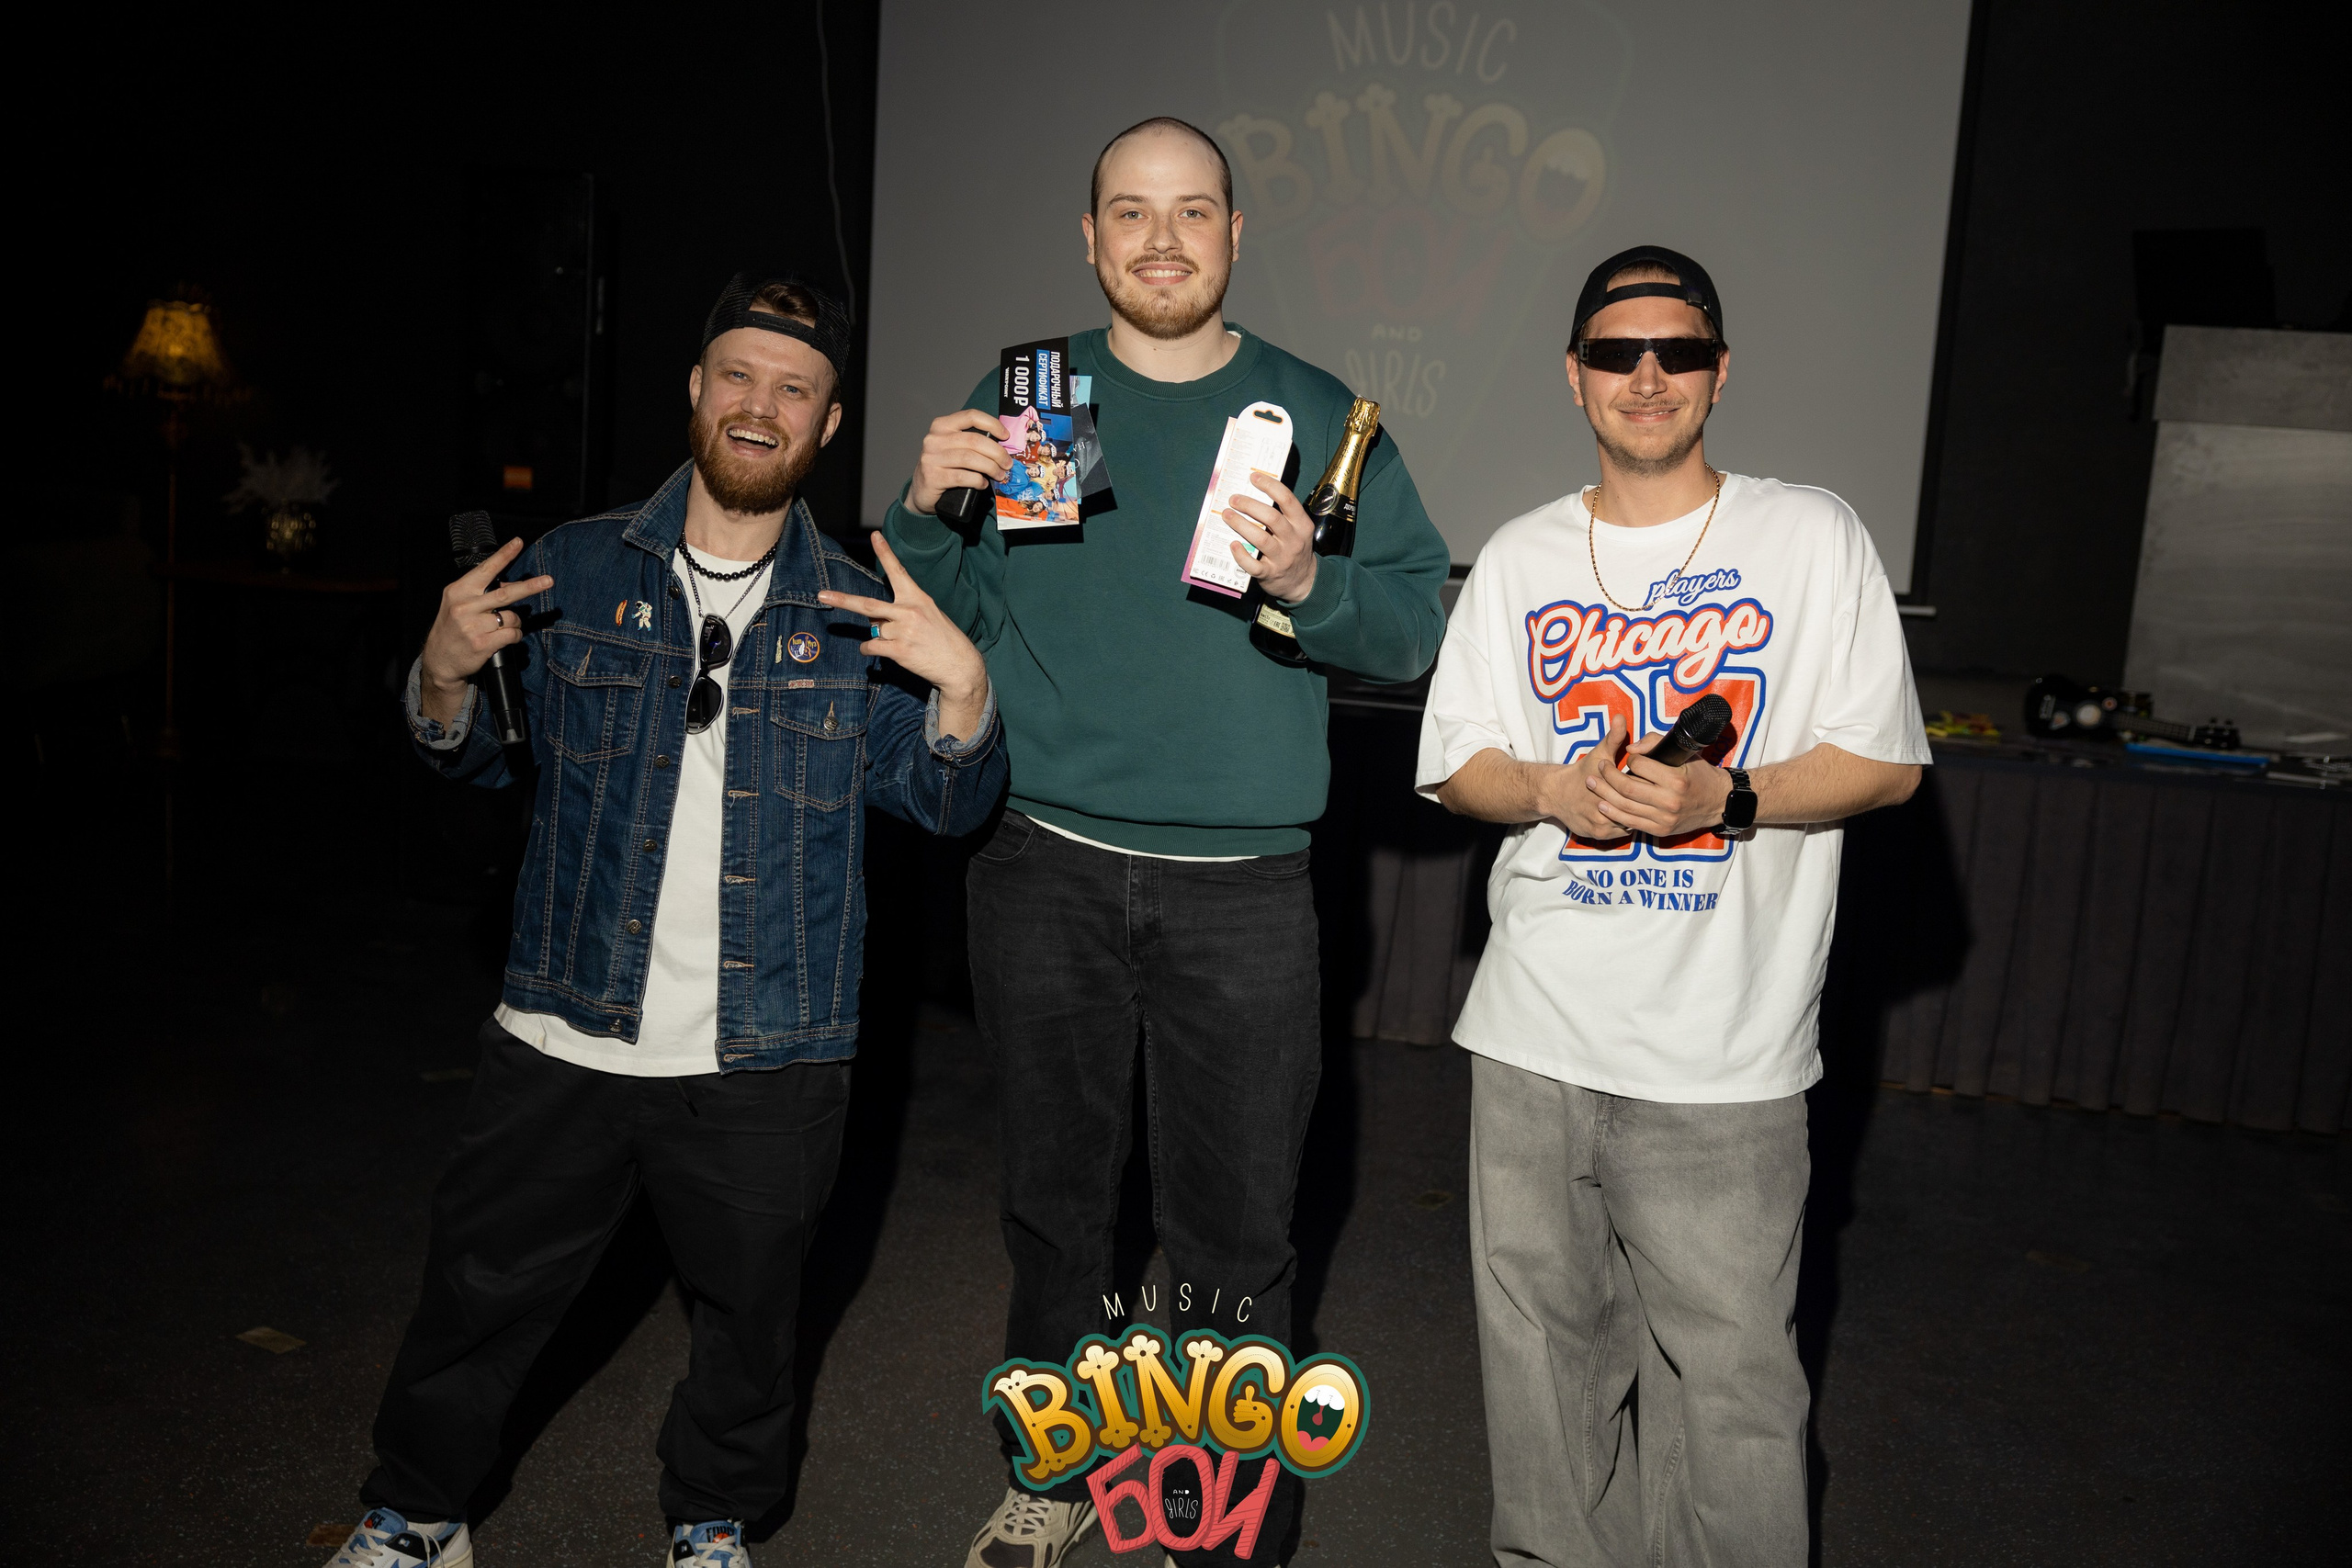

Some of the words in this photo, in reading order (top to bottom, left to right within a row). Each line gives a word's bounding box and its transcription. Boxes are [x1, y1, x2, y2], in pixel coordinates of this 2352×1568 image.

[1326, 0, 1517, 84] MUSIC
[1216, 83, 1607, 243] BINGO
[1371, 323, 1423, 344] AND
[1038, 353, 1048, 406] СЕРТИФИКАТ
[1050, 351, 1064, 408] ПОДАРОЧНЫЙ
[1643, 569, 1741, 611] players
[1525, 598, 1773, 703] Chicago
[1562, 880, 1612, 905] BORN
[1618, 890, 1634, 905] A
[1637, 889, 1719, 912] WINNER
[1587, 869, 1613, 888] NO
[1620, 868, 1667, 888] ONE
[1673, 869, 1694, 888] IS
